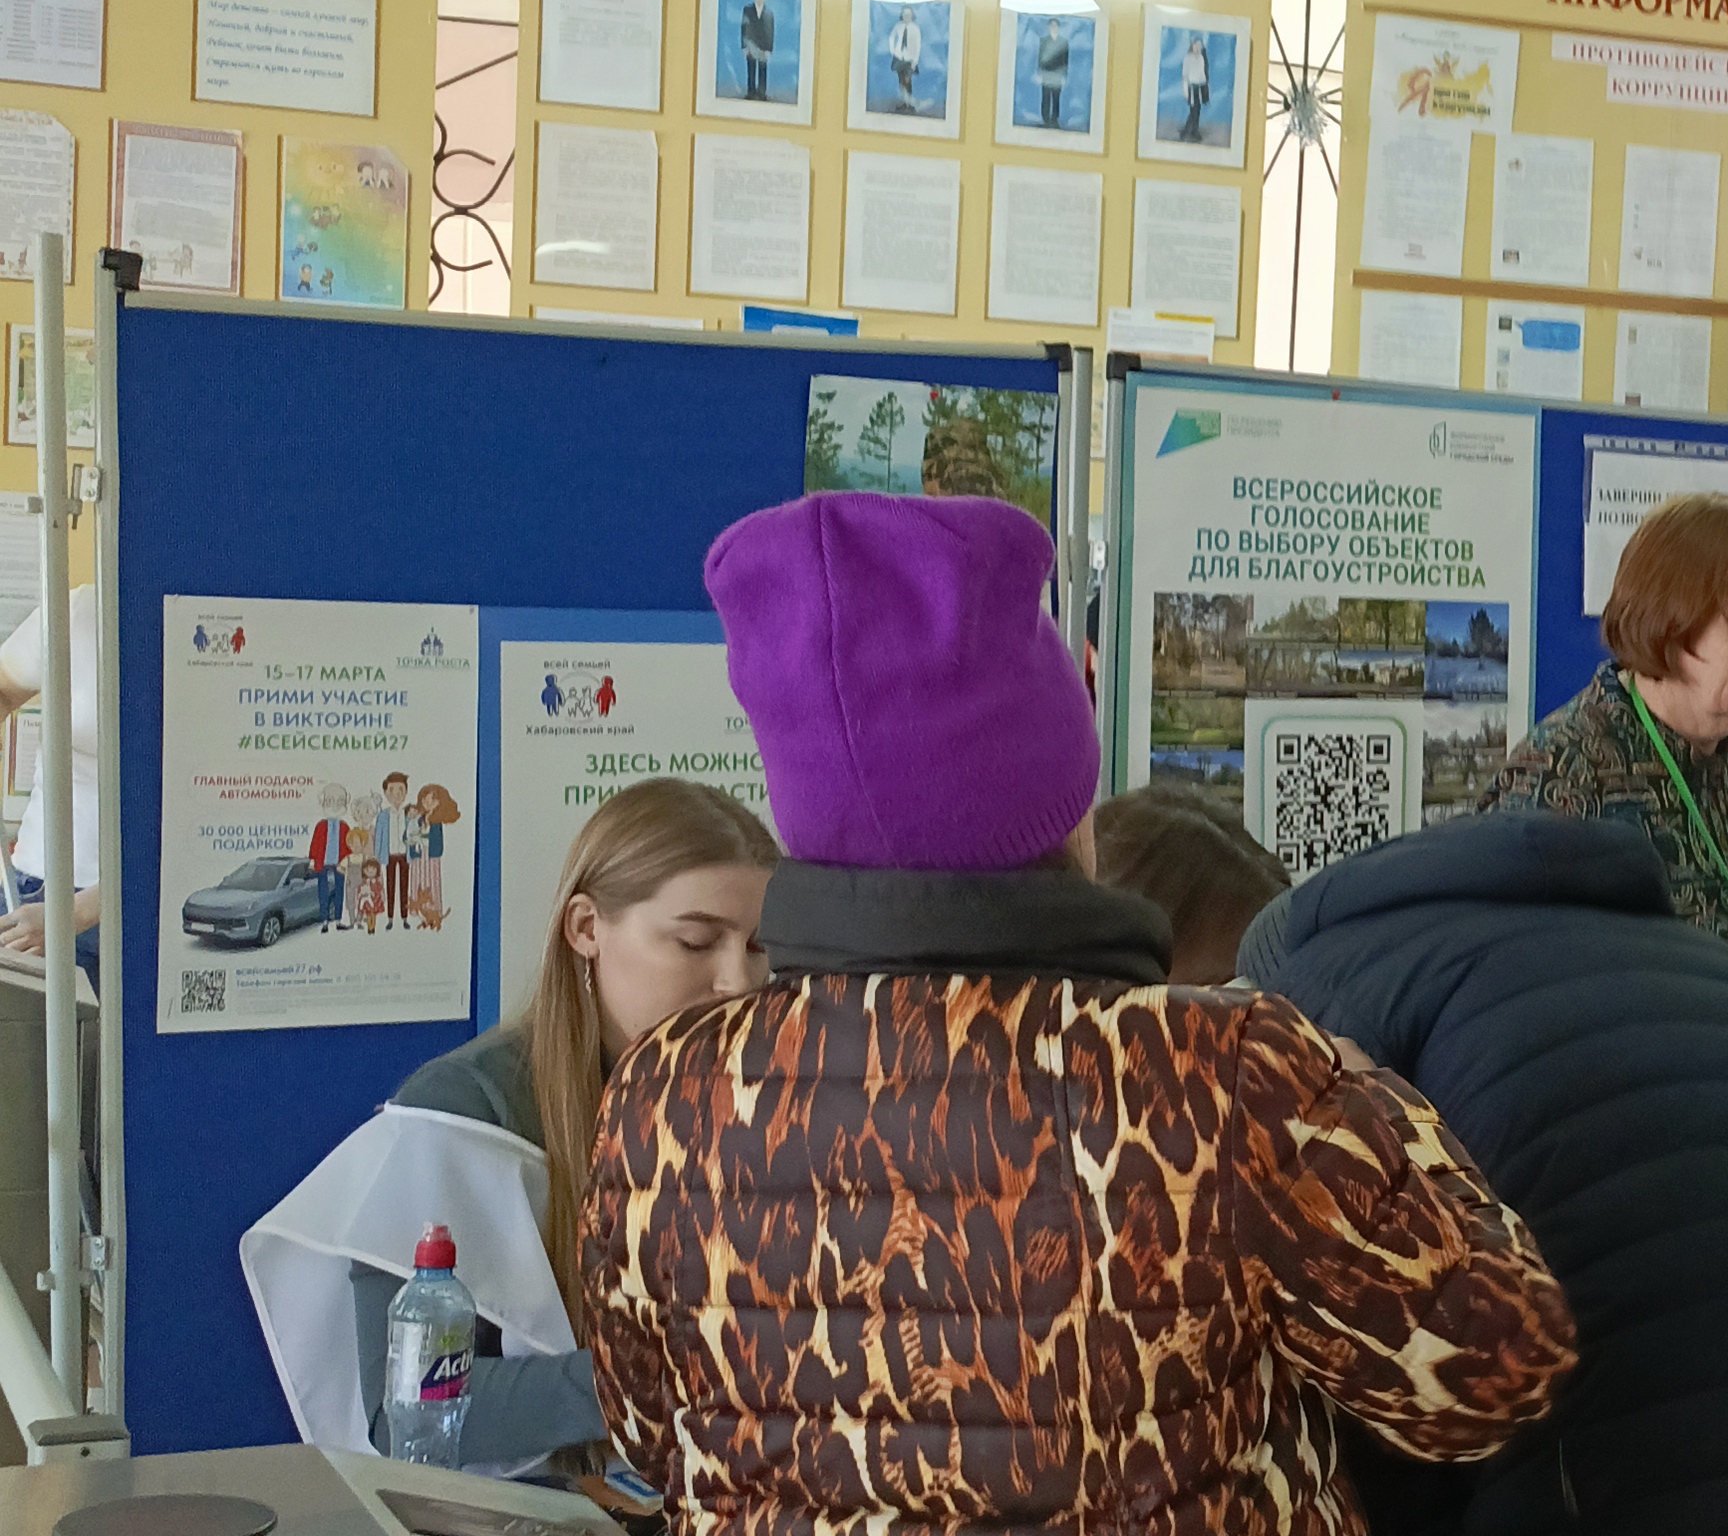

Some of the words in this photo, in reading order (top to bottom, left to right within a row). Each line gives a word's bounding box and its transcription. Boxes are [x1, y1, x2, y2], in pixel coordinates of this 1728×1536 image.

[1232, 475, 1443, 511] ВСЕРОССИЙСКОЕ
[1250, 504, 1430, 535] ГОЛОСОВАНИЕ
[1196, 527, 1230, 552] ПО
[1238, 529, 1341, 556] ВЫБОРУ
[1349, 535, 1475, 562] ОБЪЕКТОВ
[1188, 555, 1240, 583] ДЛЯ
[1248, 555, 1487, 588] БЛАГОУСТРОЙСТВА
[320, 666, 387, 683] МАРТА
[239, 688, 315, 705] ПРИМИ
[321, 689, 409, 707] УЧАСТИЕ
[254, 711, 265, 727] В
[272, 711, 393, 729] ВИКТОРИНЕ
[237, 731, 409, 751] #ВСЕЙСЕМЬЕЙ27
[585, 753, 661, 777] ЗДЕСЬ
[248, 825, 310, 837] ЦЕННЫХ
[212, 838, 294, 852] ПОДАРКОВ
